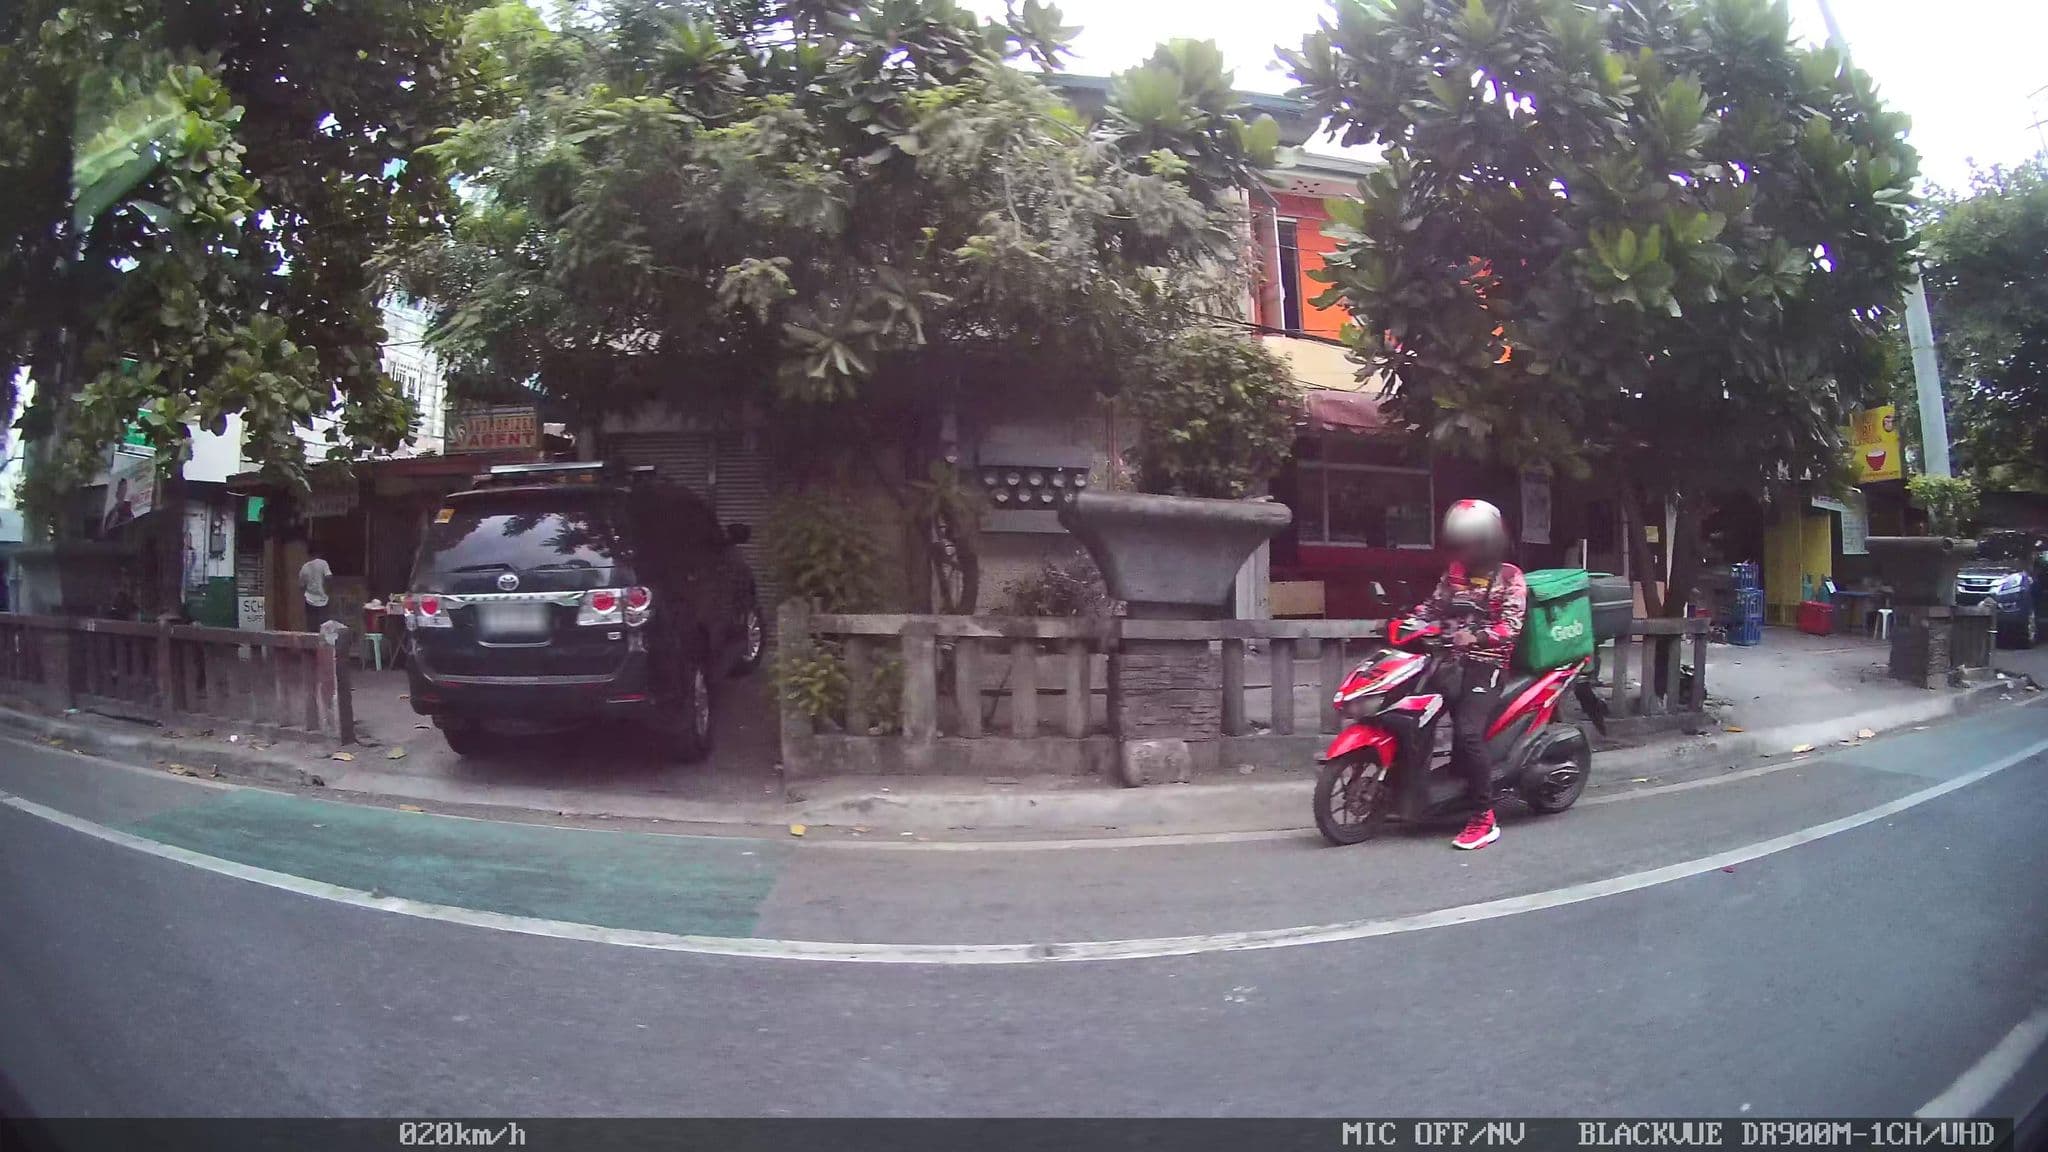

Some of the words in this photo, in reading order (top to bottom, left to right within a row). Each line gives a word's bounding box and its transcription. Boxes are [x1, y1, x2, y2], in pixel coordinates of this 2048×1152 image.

[468, 432, 535, 448] AGENT
[243, 600, 264, 613] SCH
[1551, 620, 1584, 641] Grab
